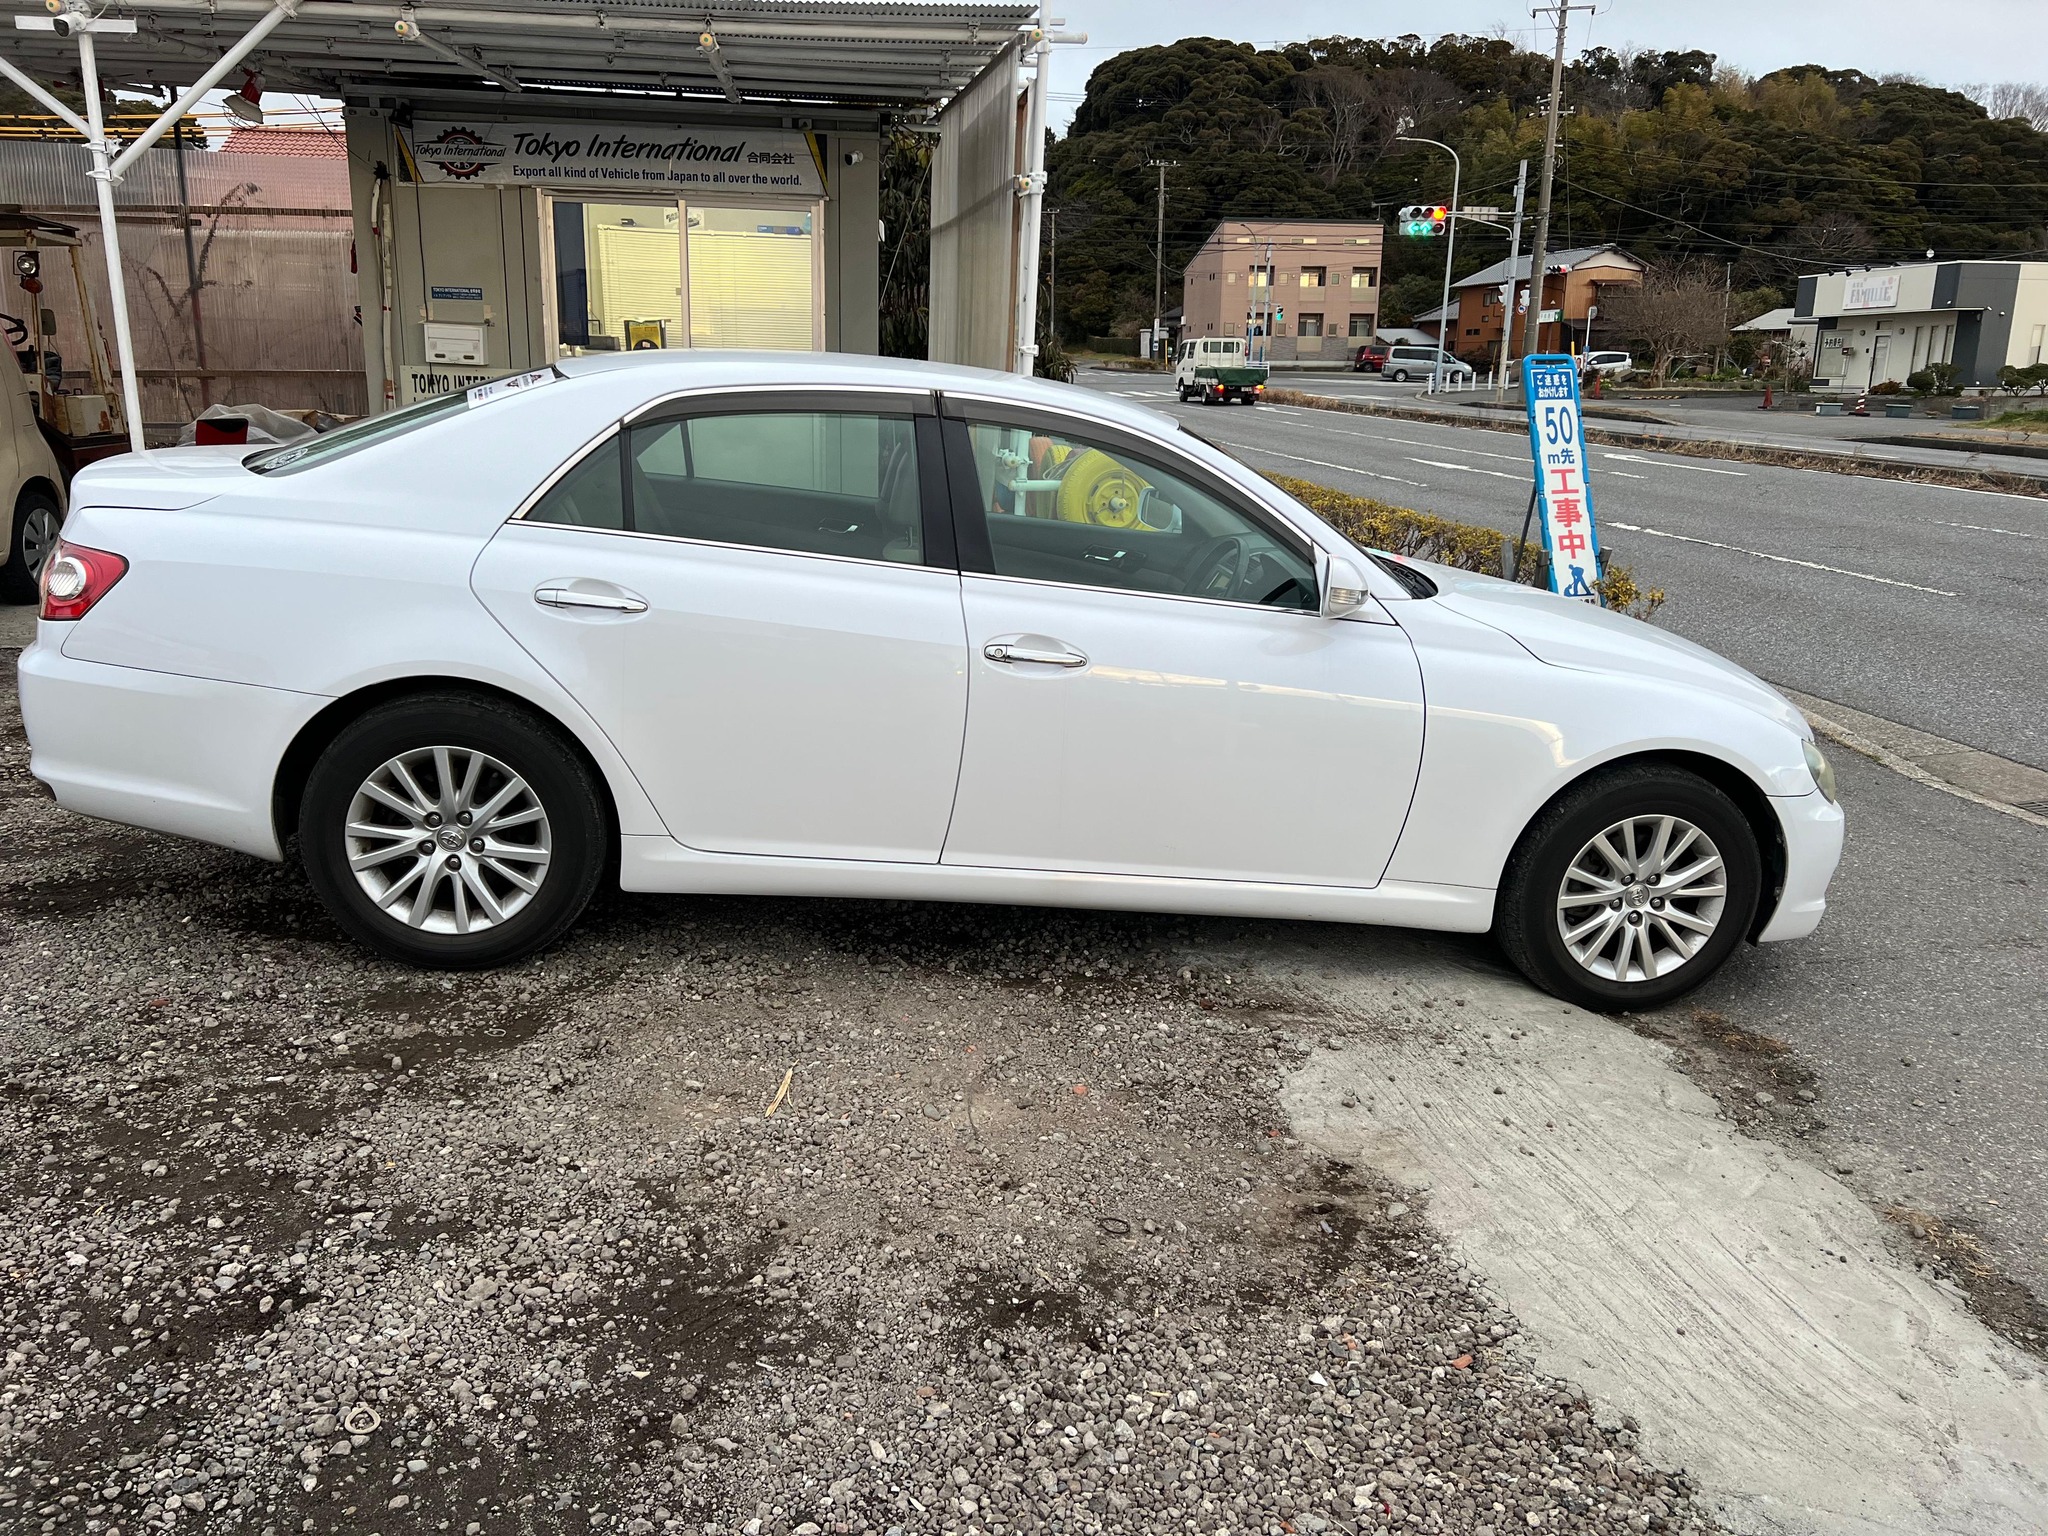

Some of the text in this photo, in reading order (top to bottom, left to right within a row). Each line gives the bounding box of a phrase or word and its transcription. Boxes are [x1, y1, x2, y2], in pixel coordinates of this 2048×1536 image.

[415, 144, 507, 157] Tokyo International
[513, 132, 795, 165] Tokyo International 合同会社
[513, 165, 802, 186] Export all kind of Vehicle from Japan to all over the world.
[411, 373, 450, 394] TOKYO
[1536, 374, 1567, 386] ご迷惑を
[1538, 386, 1568, 398] おかけします
[1545, 406, 1573, 445] 50
[1547, 448, 1575, 465] m先
[1550, 468, 1586, 560] 工事中
